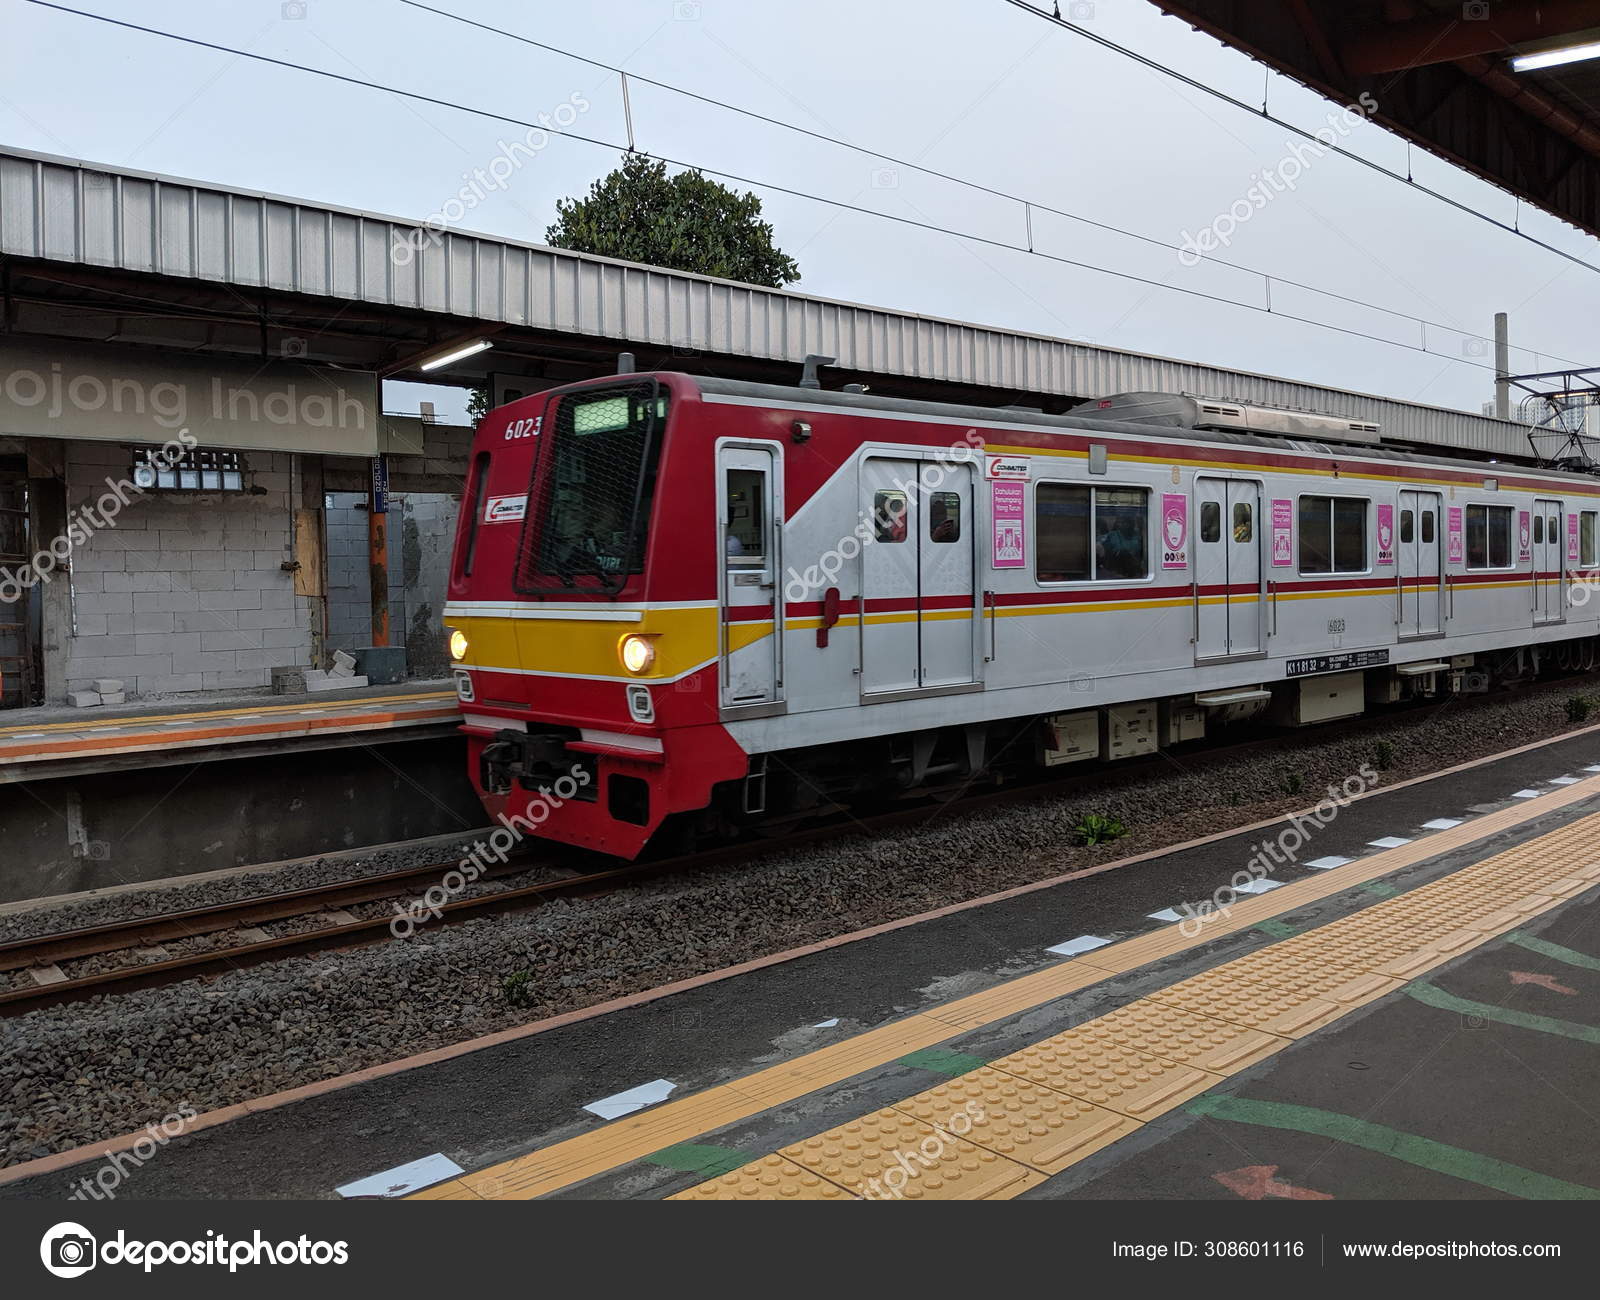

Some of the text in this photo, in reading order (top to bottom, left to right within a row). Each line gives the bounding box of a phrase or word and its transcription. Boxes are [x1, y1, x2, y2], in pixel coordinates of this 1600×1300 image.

[0, 362, 365, 430] ojong Indah
[504, 416, 543, 440] 6023
